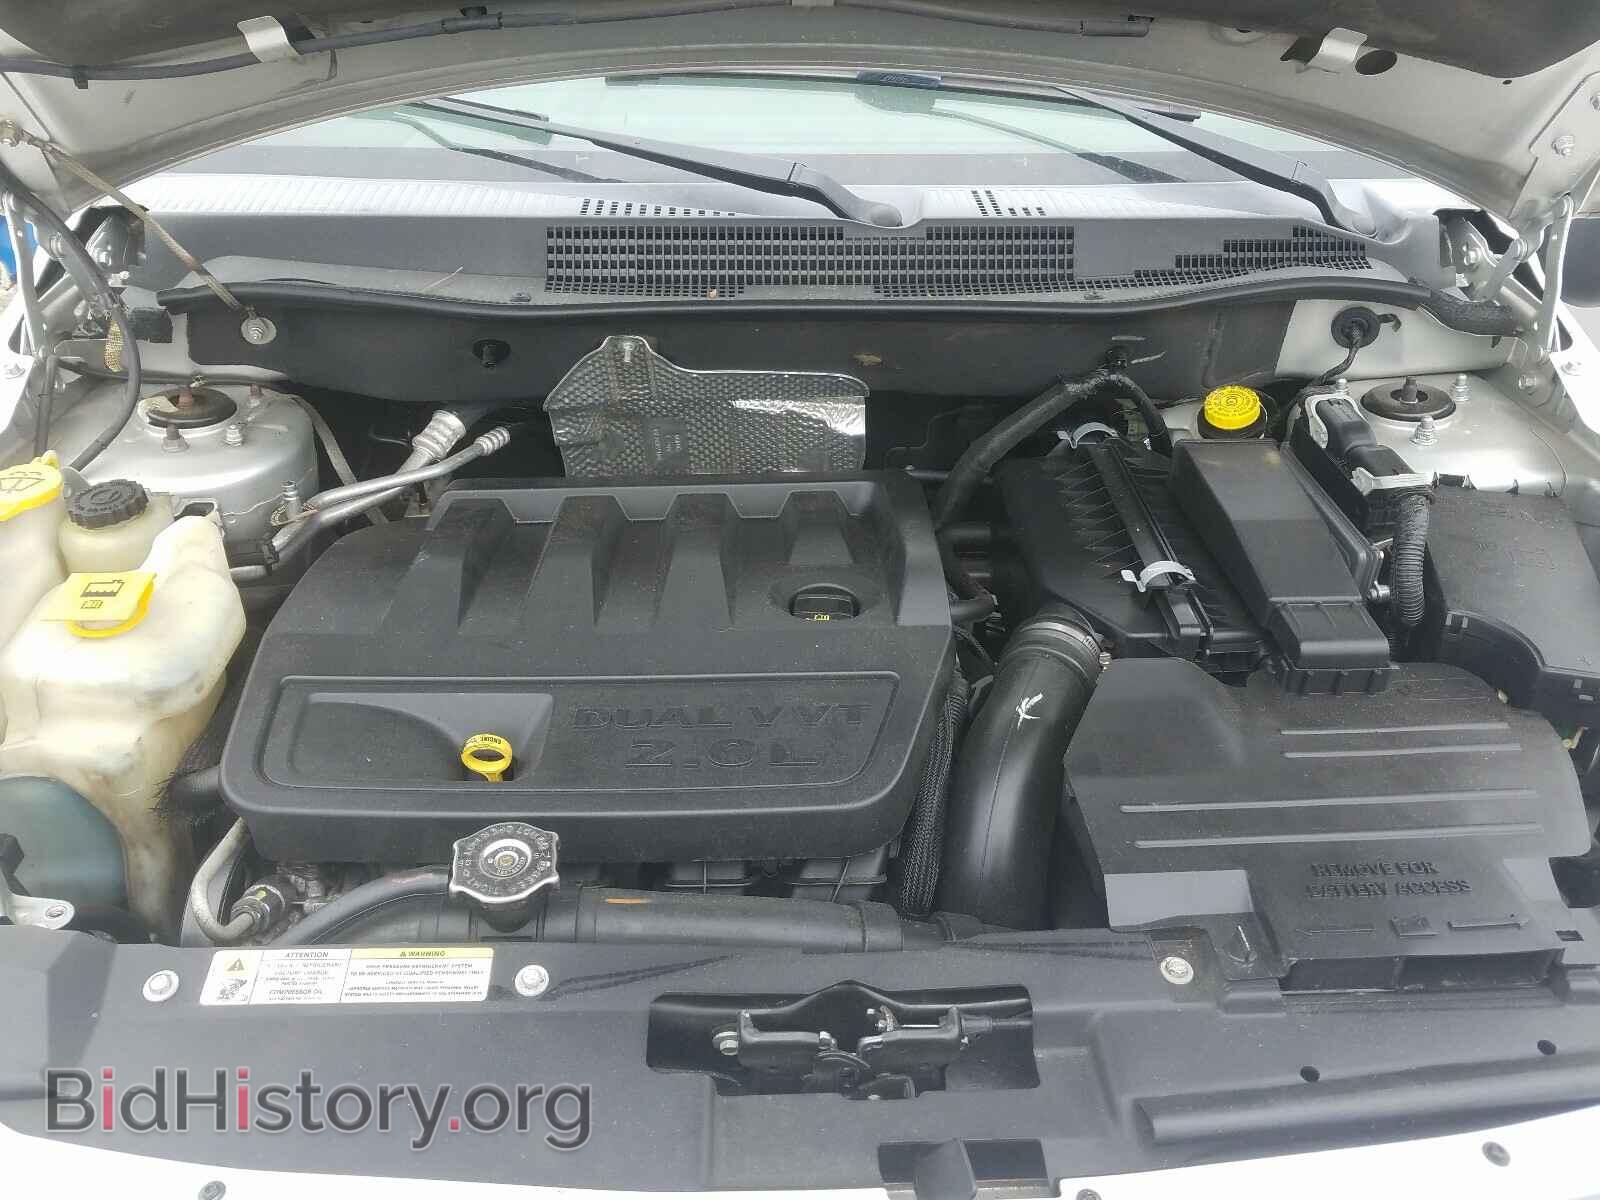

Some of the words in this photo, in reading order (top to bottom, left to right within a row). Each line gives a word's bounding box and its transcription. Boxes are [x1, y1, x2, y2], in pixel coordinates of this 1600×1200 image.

[573, 704, 733, 729] DUAL
[622, 738, 820, 768] 2.0L
[1310, 862, 1396, 878] REMOVE
[1396, 861, 1441, 876] FOR
[1396, 880, 1473, 897] ACCESS
[284, 951, 329, 959] ATTENTION
